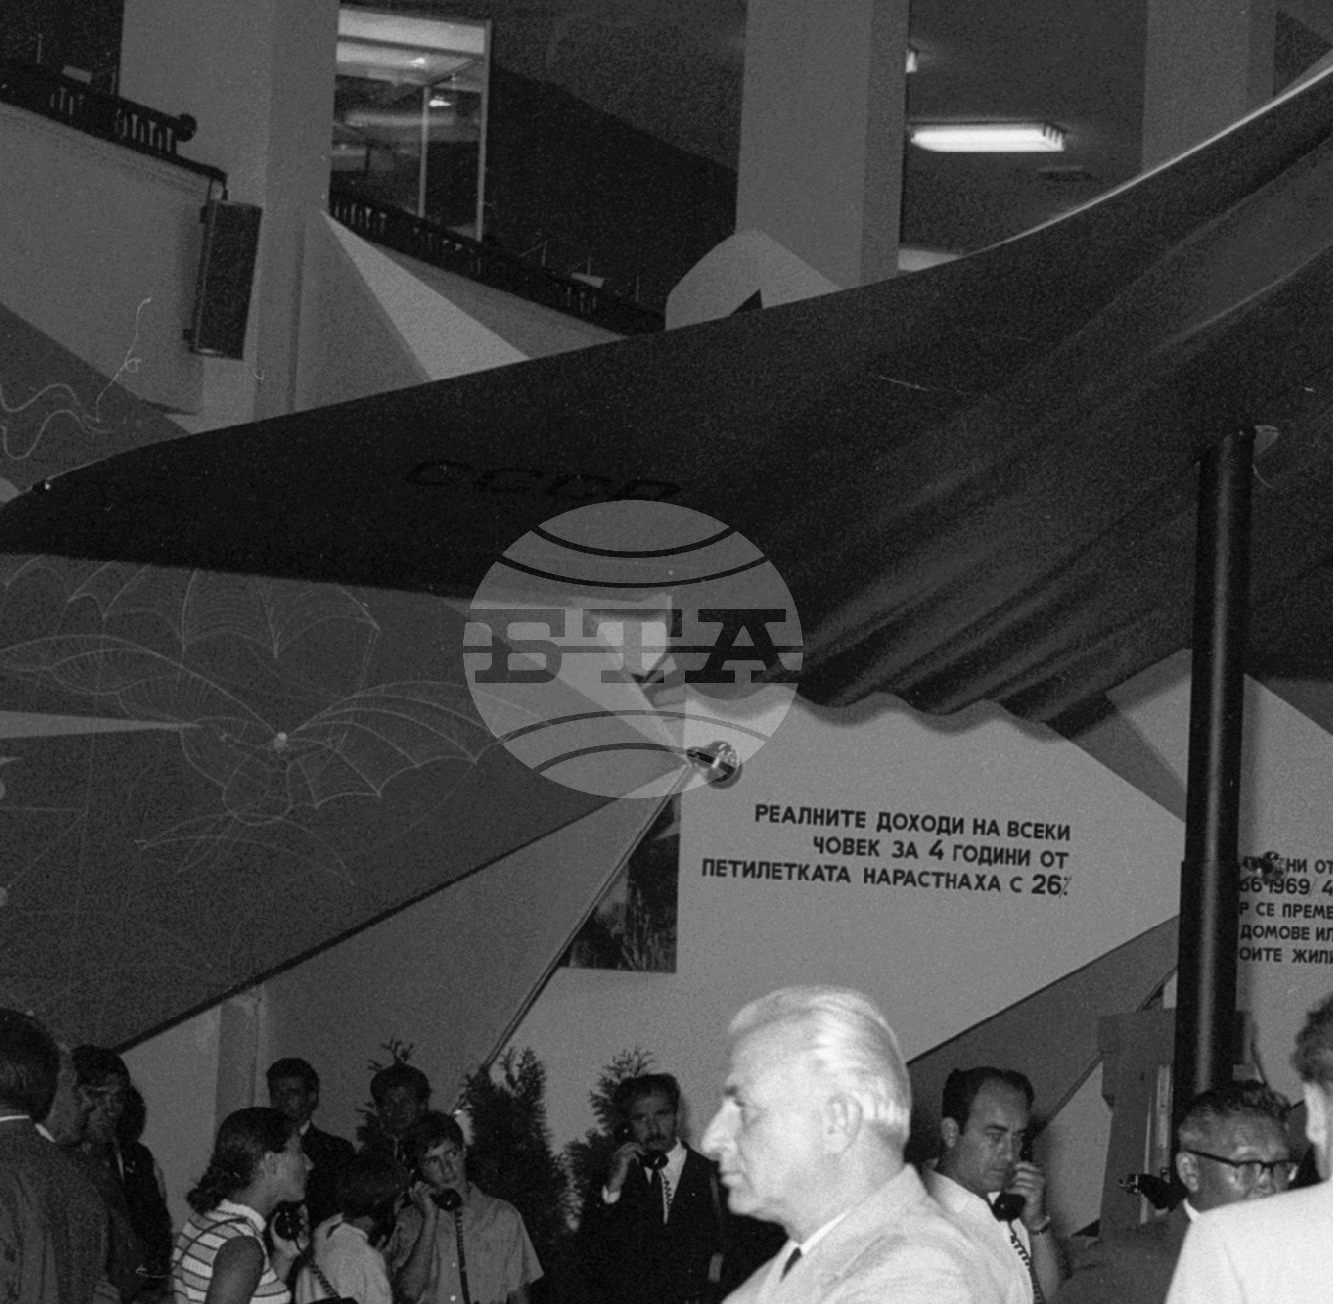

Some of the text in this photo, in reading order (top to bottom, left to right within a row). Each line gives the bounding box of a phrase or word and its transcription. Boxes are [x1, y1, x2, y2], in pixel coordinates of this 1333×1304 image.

[754, 804, 1071, 841] РЕАЛНИТЕ ДОХОДИ НА ВСЕКИ
[813, 836, 1069, 870] ЧОВЕК ЗА 4 ГОДИНИ ОТ
[702, 858, 851, 883] ПЕТИЛЕТКАТА
[863, 867, 1001, 892] НАРАСТНАХА
[1256, 902, 1275, 917] СЕ
[1240, 924, 1310, 941] ДОМОВЕ
